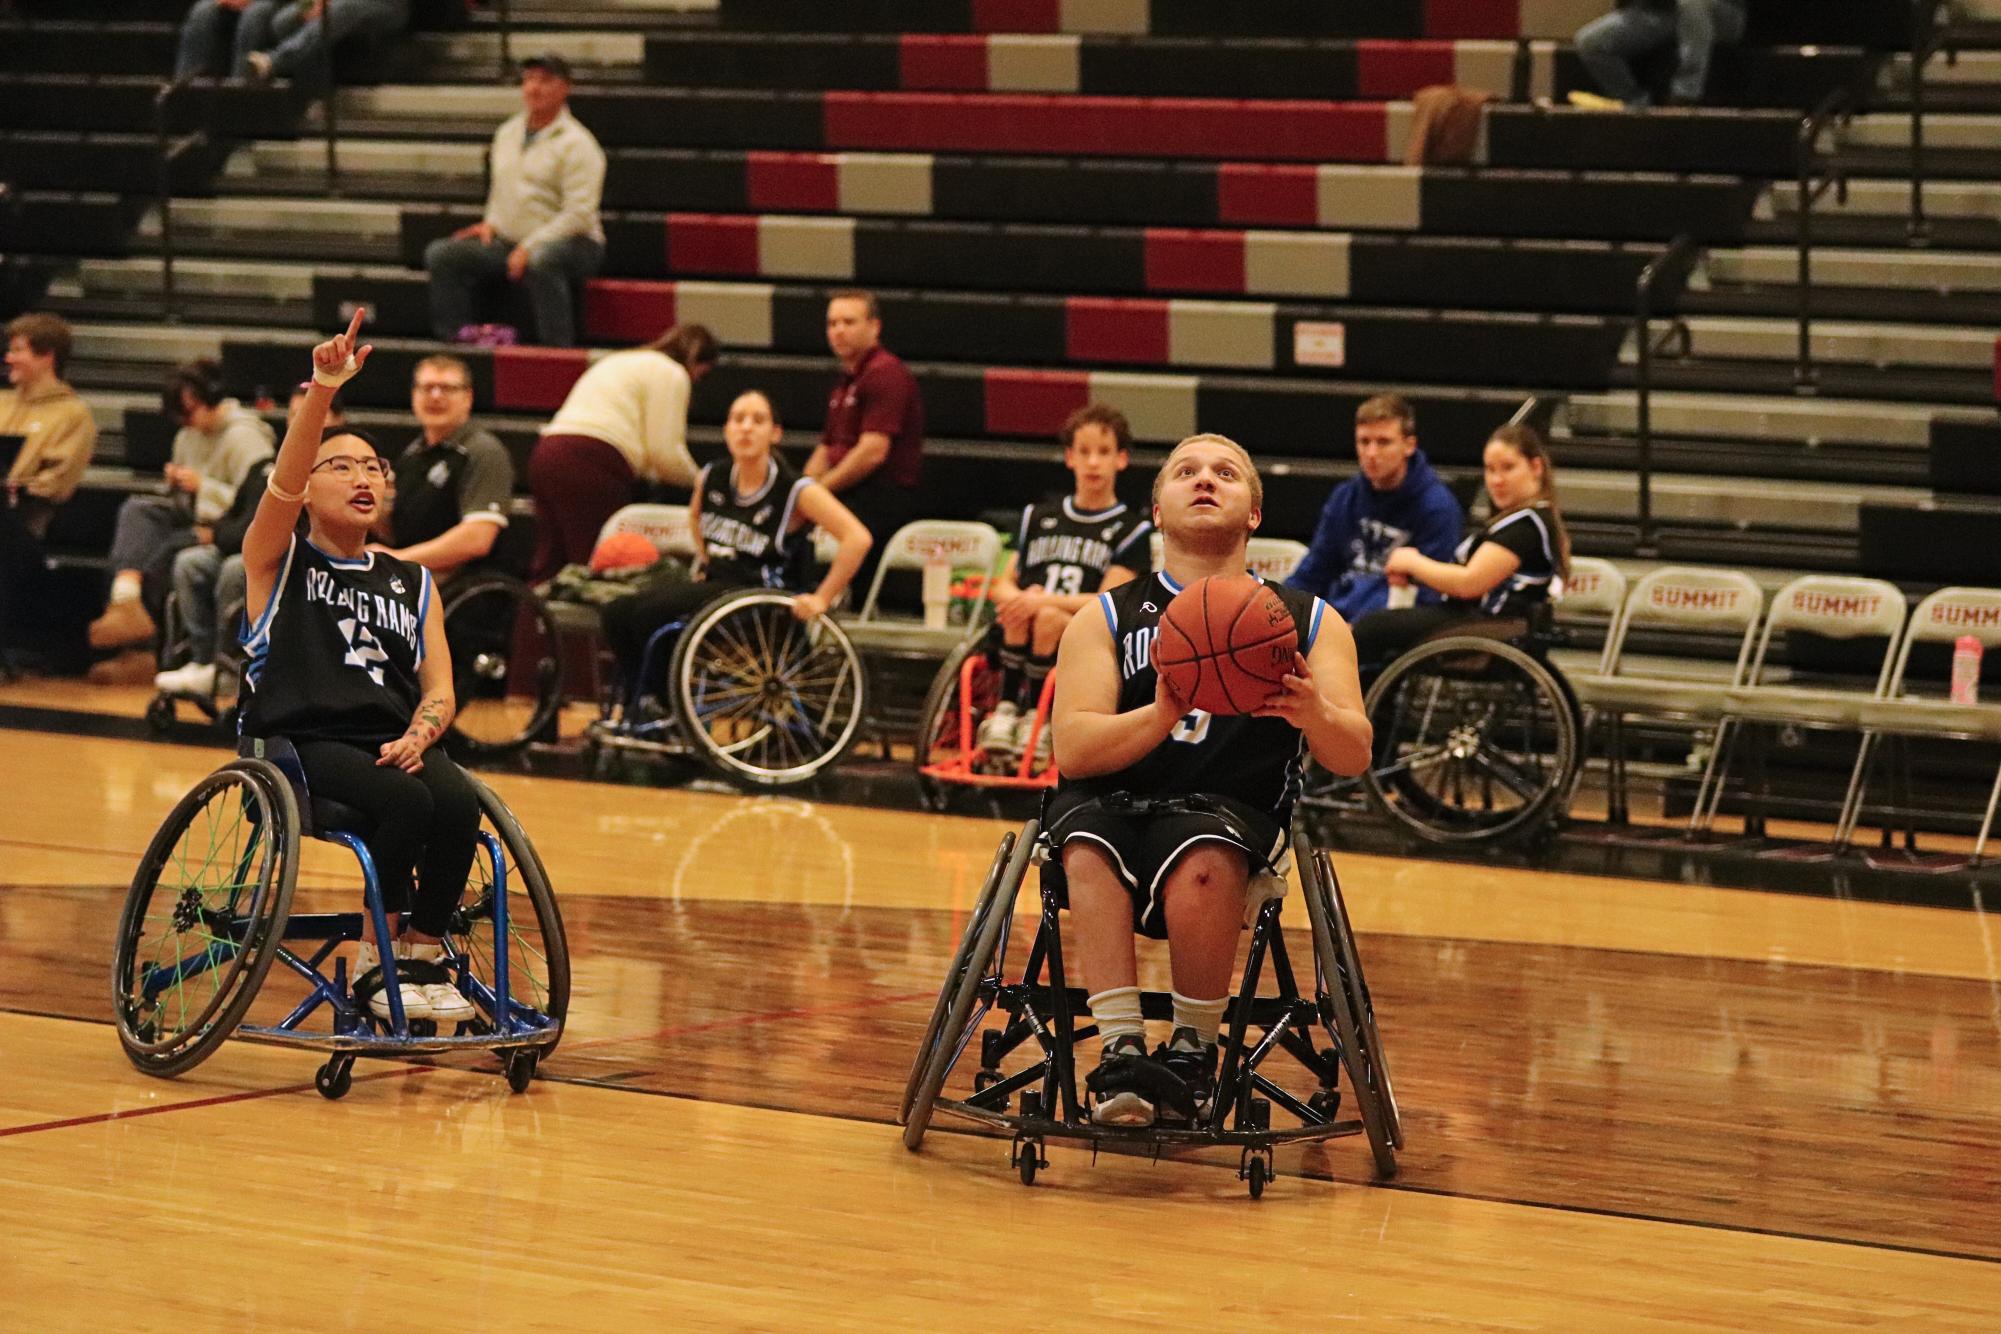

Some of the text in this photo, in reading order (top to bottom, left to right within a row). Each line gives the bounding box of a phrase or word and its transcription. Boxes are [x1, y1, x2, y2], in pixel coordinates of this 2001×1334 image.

[1045, 563, 1083, 596] 13
[1652, 586, 1739, 608] SUMMIT
[1793, 591, 1881, 614] SUMMIT
[374, 595, 418, 651] RAMS
[338, 618, 389, 686] 12
